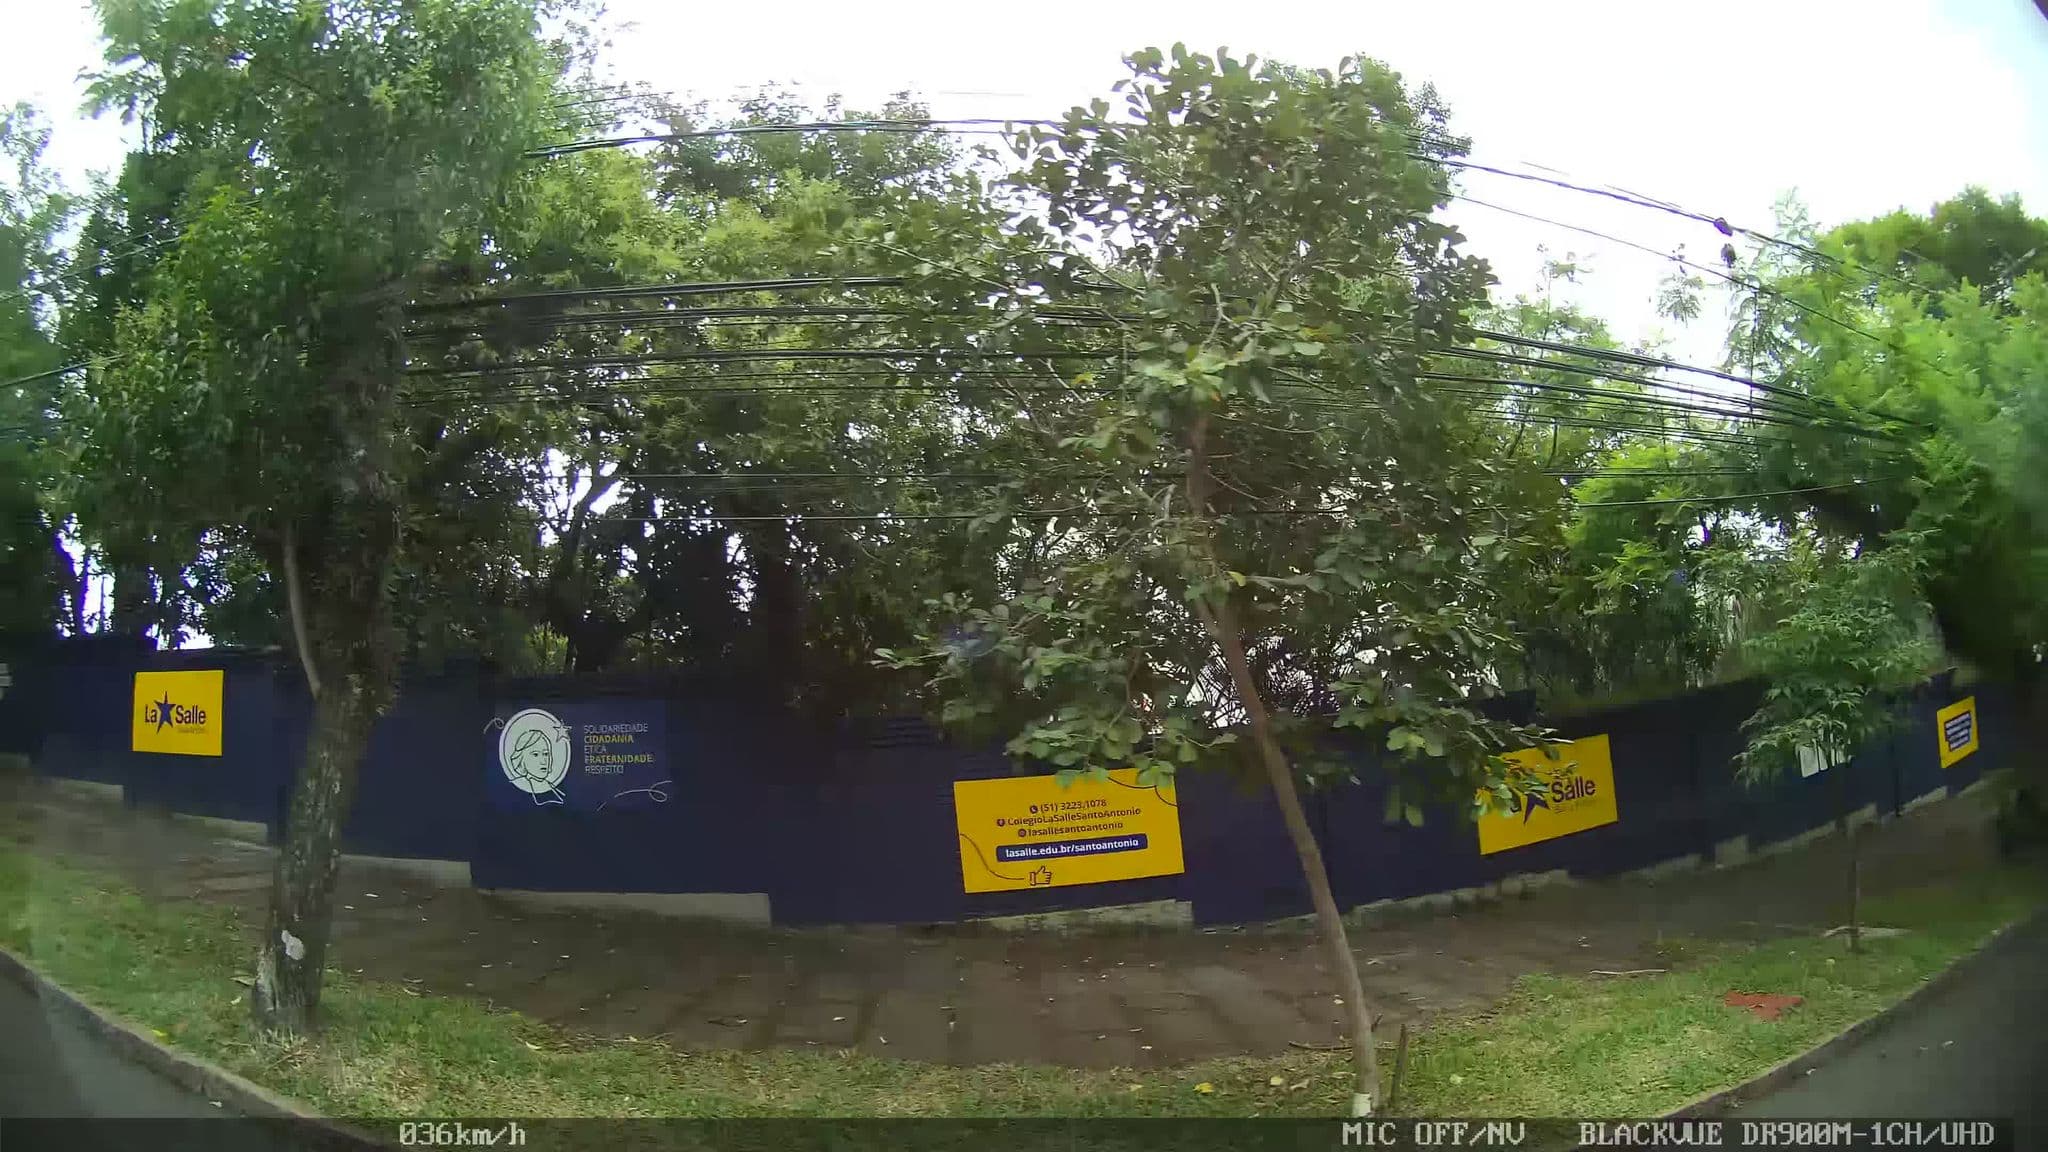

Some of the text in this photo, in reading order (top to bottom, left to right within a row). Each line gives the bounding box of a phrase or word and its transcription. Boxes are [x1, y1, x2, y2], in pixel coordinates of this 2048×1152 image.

[145, 704, 207, 725] La Salle
[583, 723, 649, 734] SOLIDARIEDADE
[583, 734, 635, 744] CIDADANIA
[584, 754, 655, 765] FRATERNIDADE
[584, 765, 625, 775] RESPEITO
[1551, 776, 1596, 803] Salle
[1040, 803, 1058, 814] (51)
[1028, 821, 1124, 837] lasallesantoantonio
[1005, 838, 1139, 858] lasalle.edu.br/santoantonio
